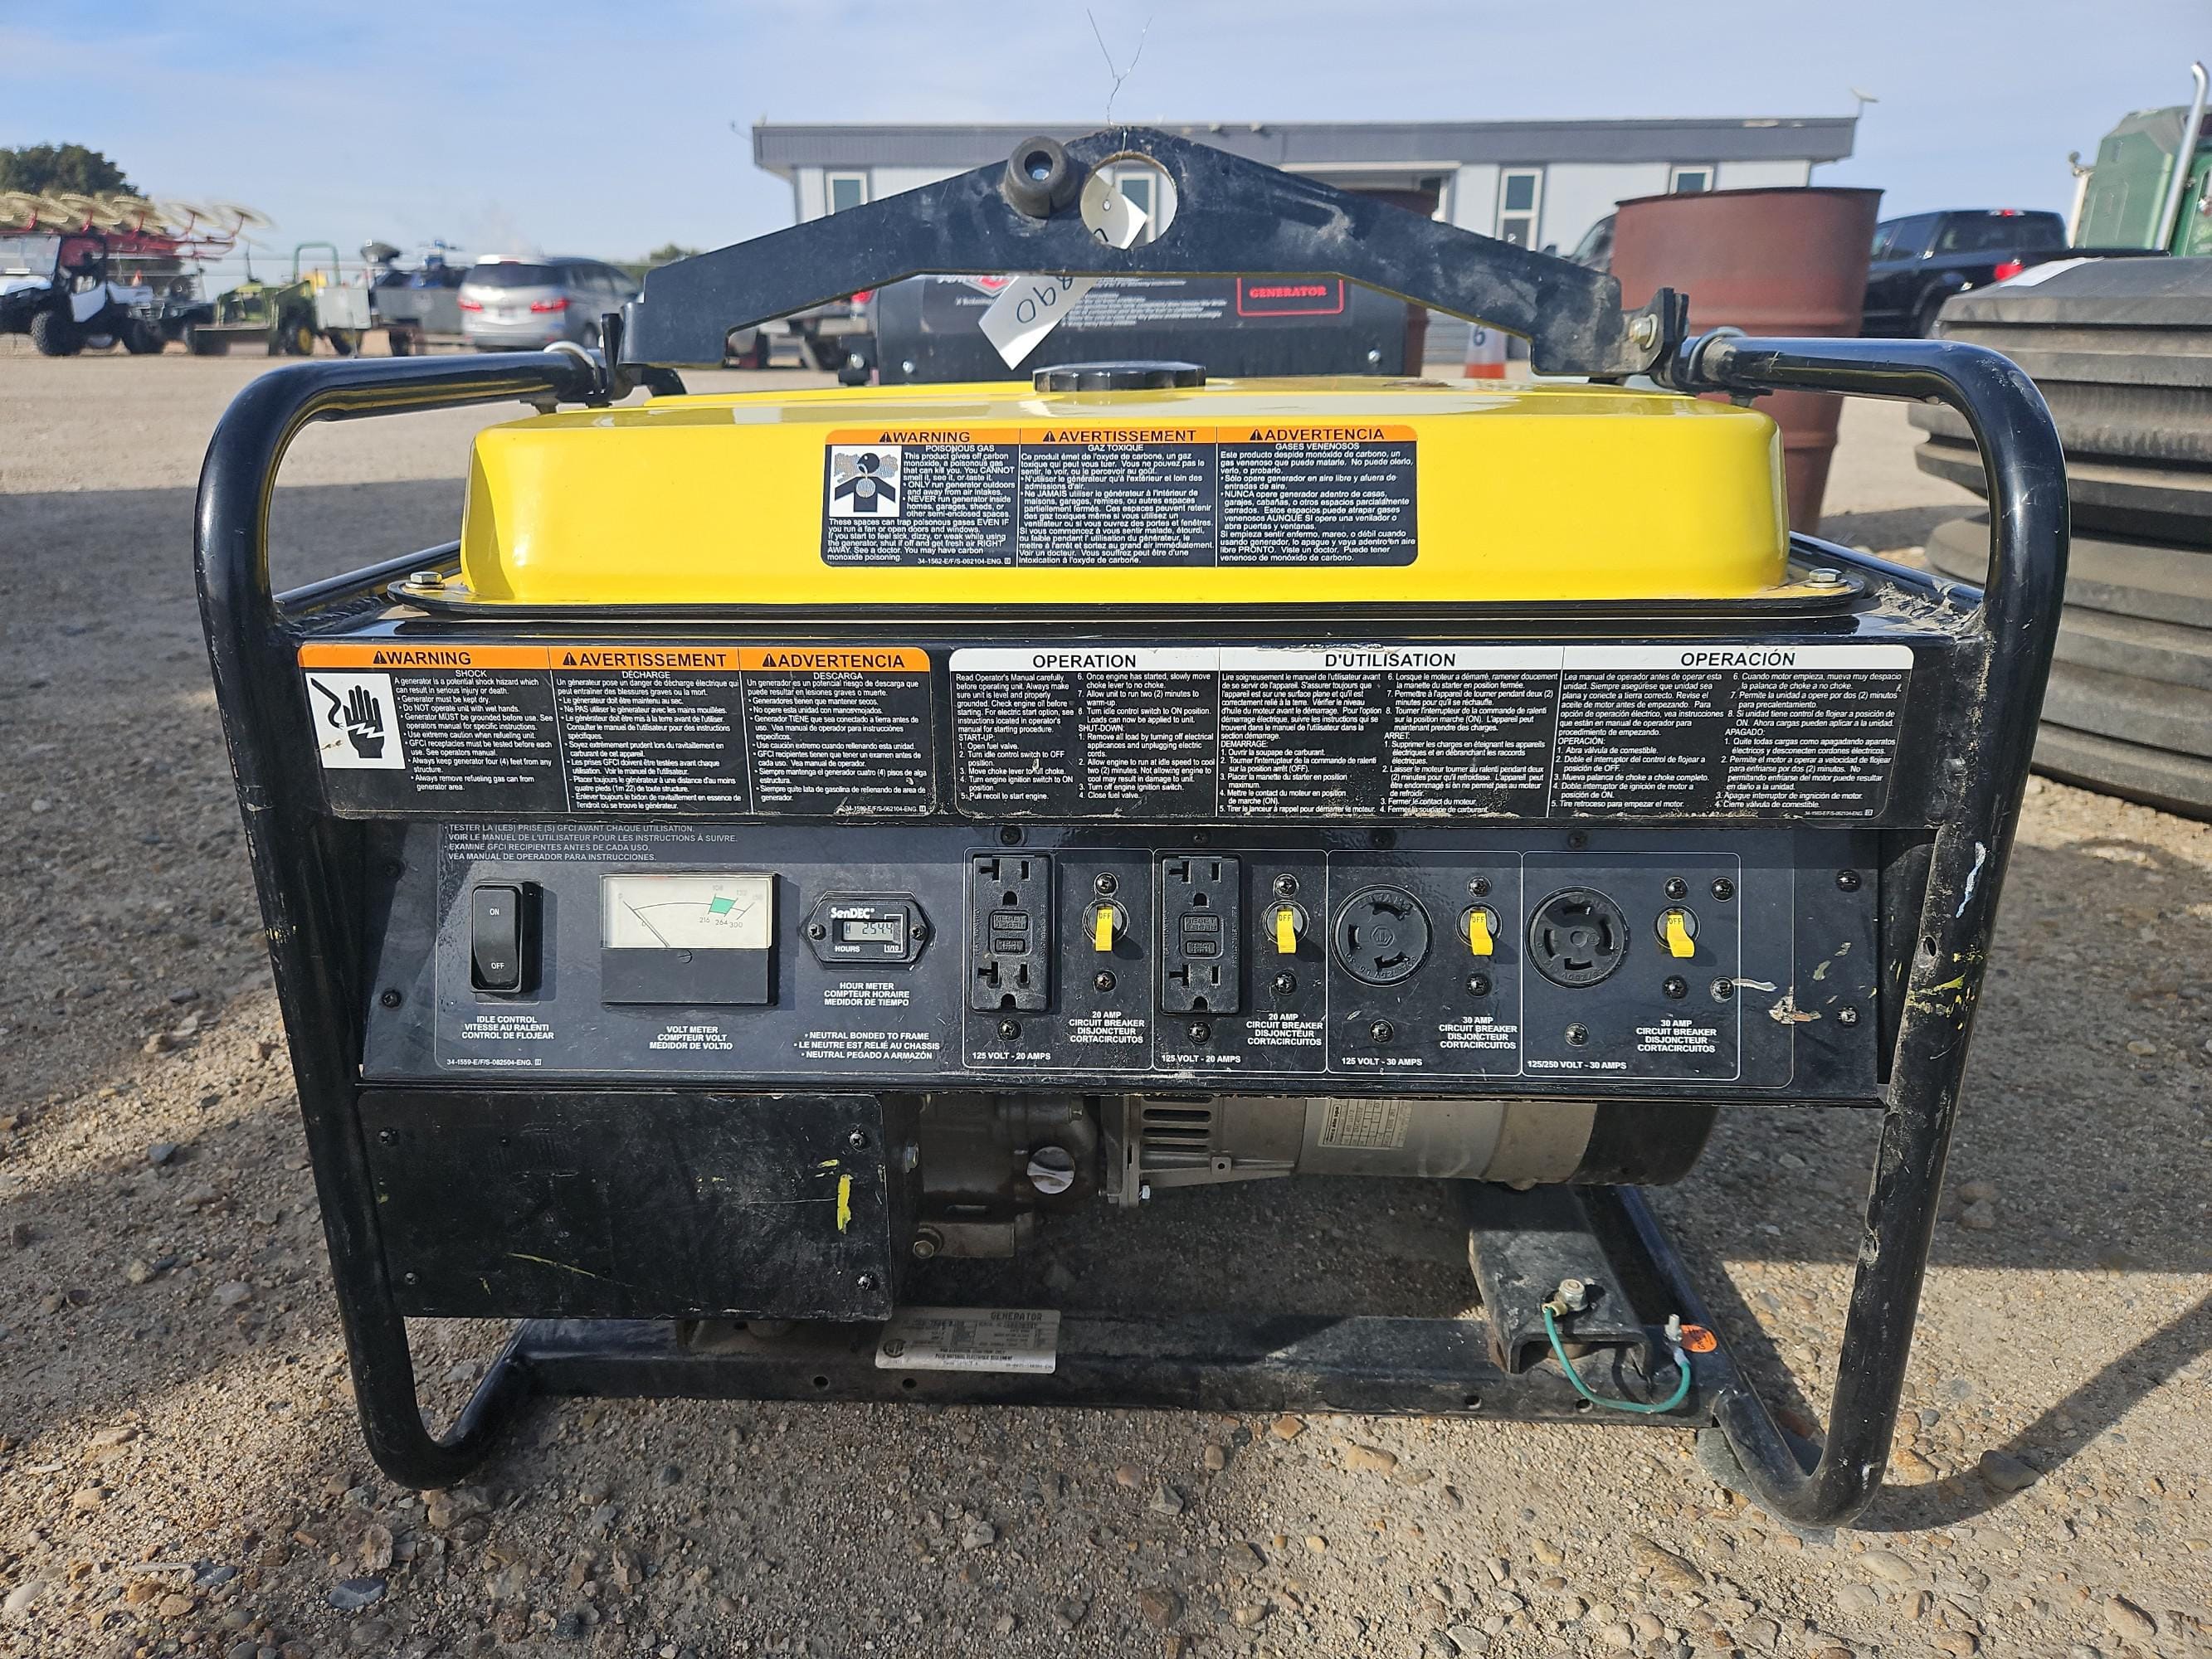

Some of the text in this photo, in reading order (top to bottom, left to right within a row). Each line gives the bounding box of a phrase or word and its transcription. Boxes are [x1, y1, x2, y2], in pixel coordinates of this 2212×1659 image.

[1250, 286, 1327, 299] GENERATOR
[893, 431, 969, 443] WARNING
[1059, 431, 1196, 442] AVERTISSEMENT
[1264, 429, 1384, 440] ADVERTENCIA
[385, 652, 470, 664] WARNING
[579, 653, 726, 667] AVERTISSEMENT
[778, 654, 904, 668] ADVERTENCIA
[1032, 655, 1135, 668] OPERATION
[1325, 654, 1455, 667] D'UTILISATION
[1681, 650, 1795, 666] OPERACIÓN
[462, 696, 477, 705] kept
[478, 696, 490, 705] dry.
[697, 834, 703, 843] À
[516, 853, 562, 861] OPERADOR
[831, 907, 871, 919] SenDEC
[824, 998, 863, 1006] MEDIDOR
[1439, 1024, 1517, 1033] CIRCUIT BREAKER
[1673, 1028, 1717, 1036] BREAKER
[461, 1031, 501, 1039] CONTROL
[657, 1034, 704, 1042] COMPTEUR
[809, 1032, 929, 1040] NEUTRAL BONDED TO FRAME
[1069, 1035, 1143, 1044] CORTACIRCUITOS
[1447, 1033, 1508, 1041] DISJONCTEUR
[798, 1039, 940, 1050] LE NEUTRE EST RELIÉ AU CHASSIS
[1247, 1038, 1322, 1046] CORTACIRCUITOS
[1644, 1036, 1708, 1044] DISJONCTEUR
[649, 1042, 733, 1050] MEDIDOR DE VOLTIO
[1440, 1041, 1516, 1049] CORTACIRCUITOS
[1637, 1044, 1715, 1053] CORTACIRCUITOS
[806, 1049, 932, 1059] NEUTRAL PEGADO A ARMAZÓN
[1527, 1060, 1558, 1068] 125/250
[1589, 1061, 1600, 1069] 30
[1601, 1061, 1626, 1069] AMPS
